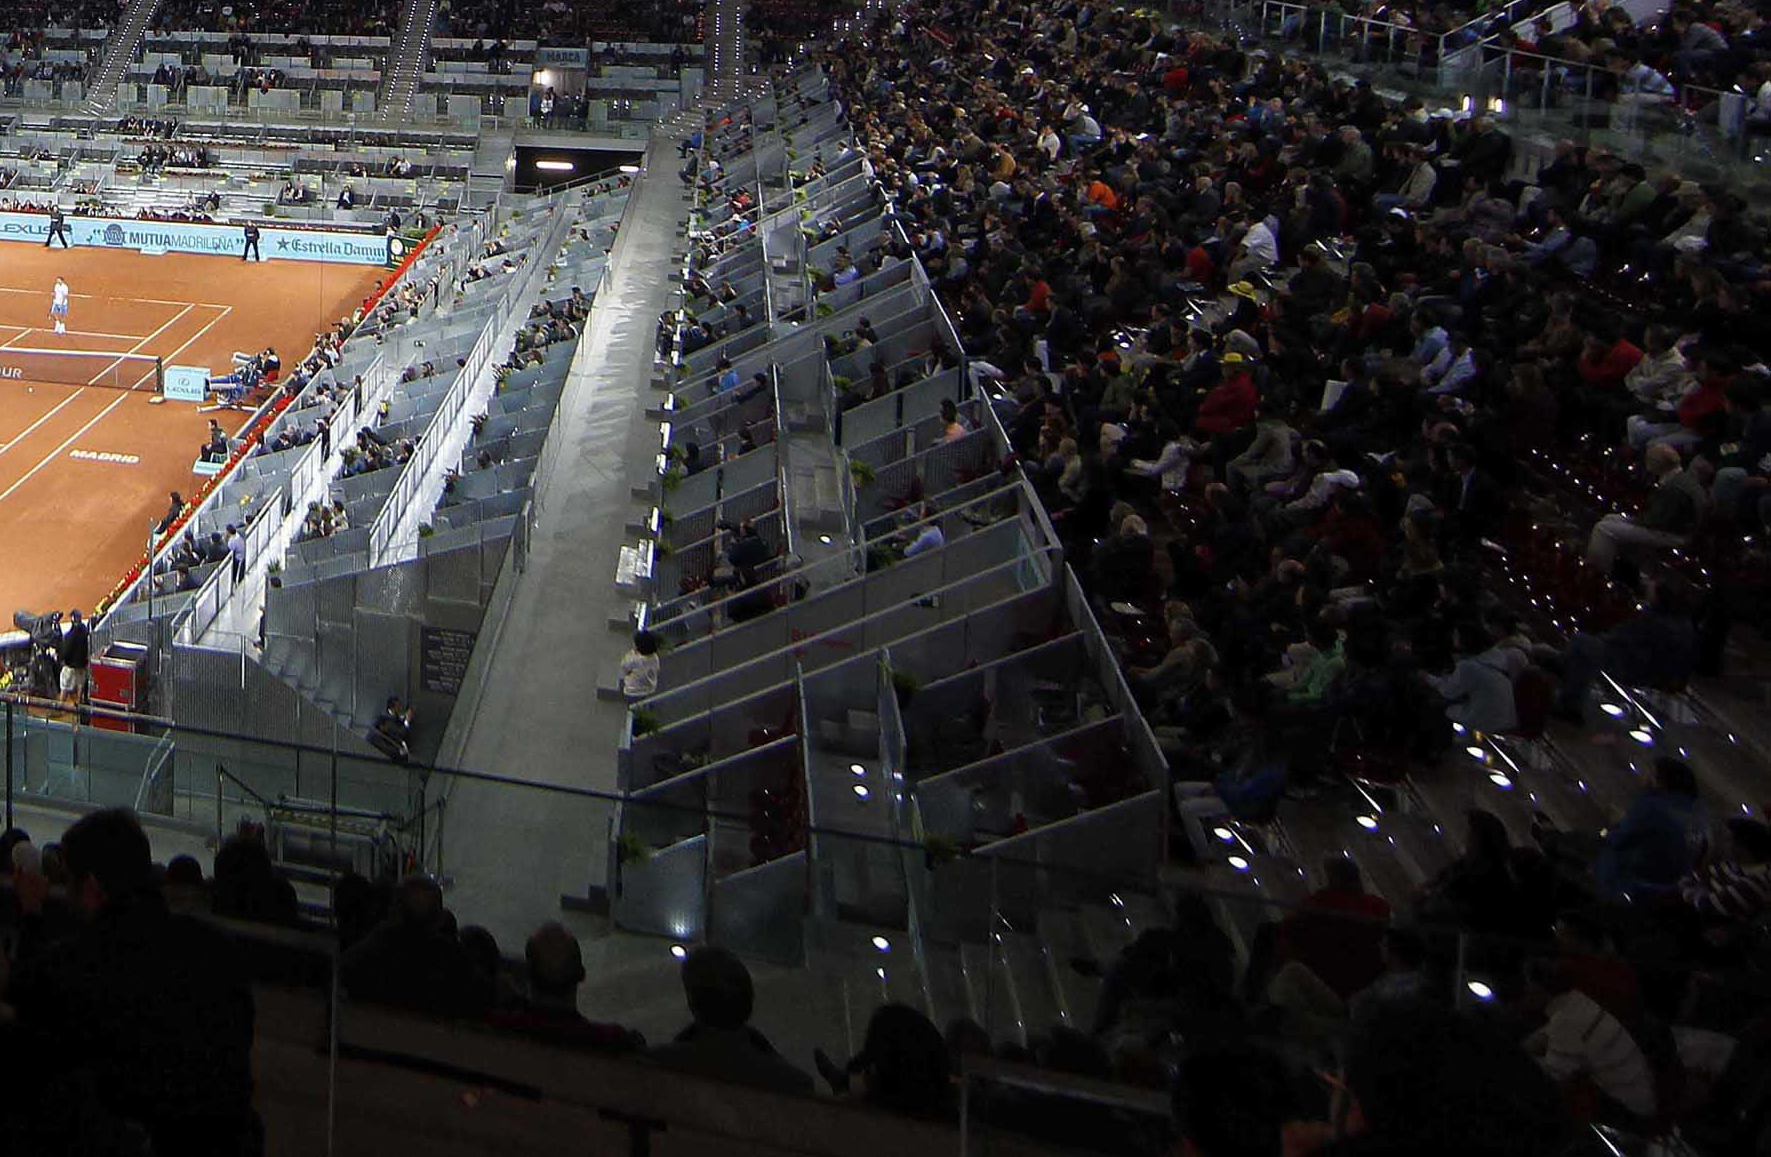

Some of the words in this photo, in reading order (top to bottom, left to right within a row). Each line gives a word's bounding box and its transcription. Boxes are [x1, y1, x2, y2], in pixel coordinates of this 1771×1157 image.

[291, 239, 341, 254] Estrella
[343, 242, 386, 258] Damm
[69, 449, 140, 464] MADRID
